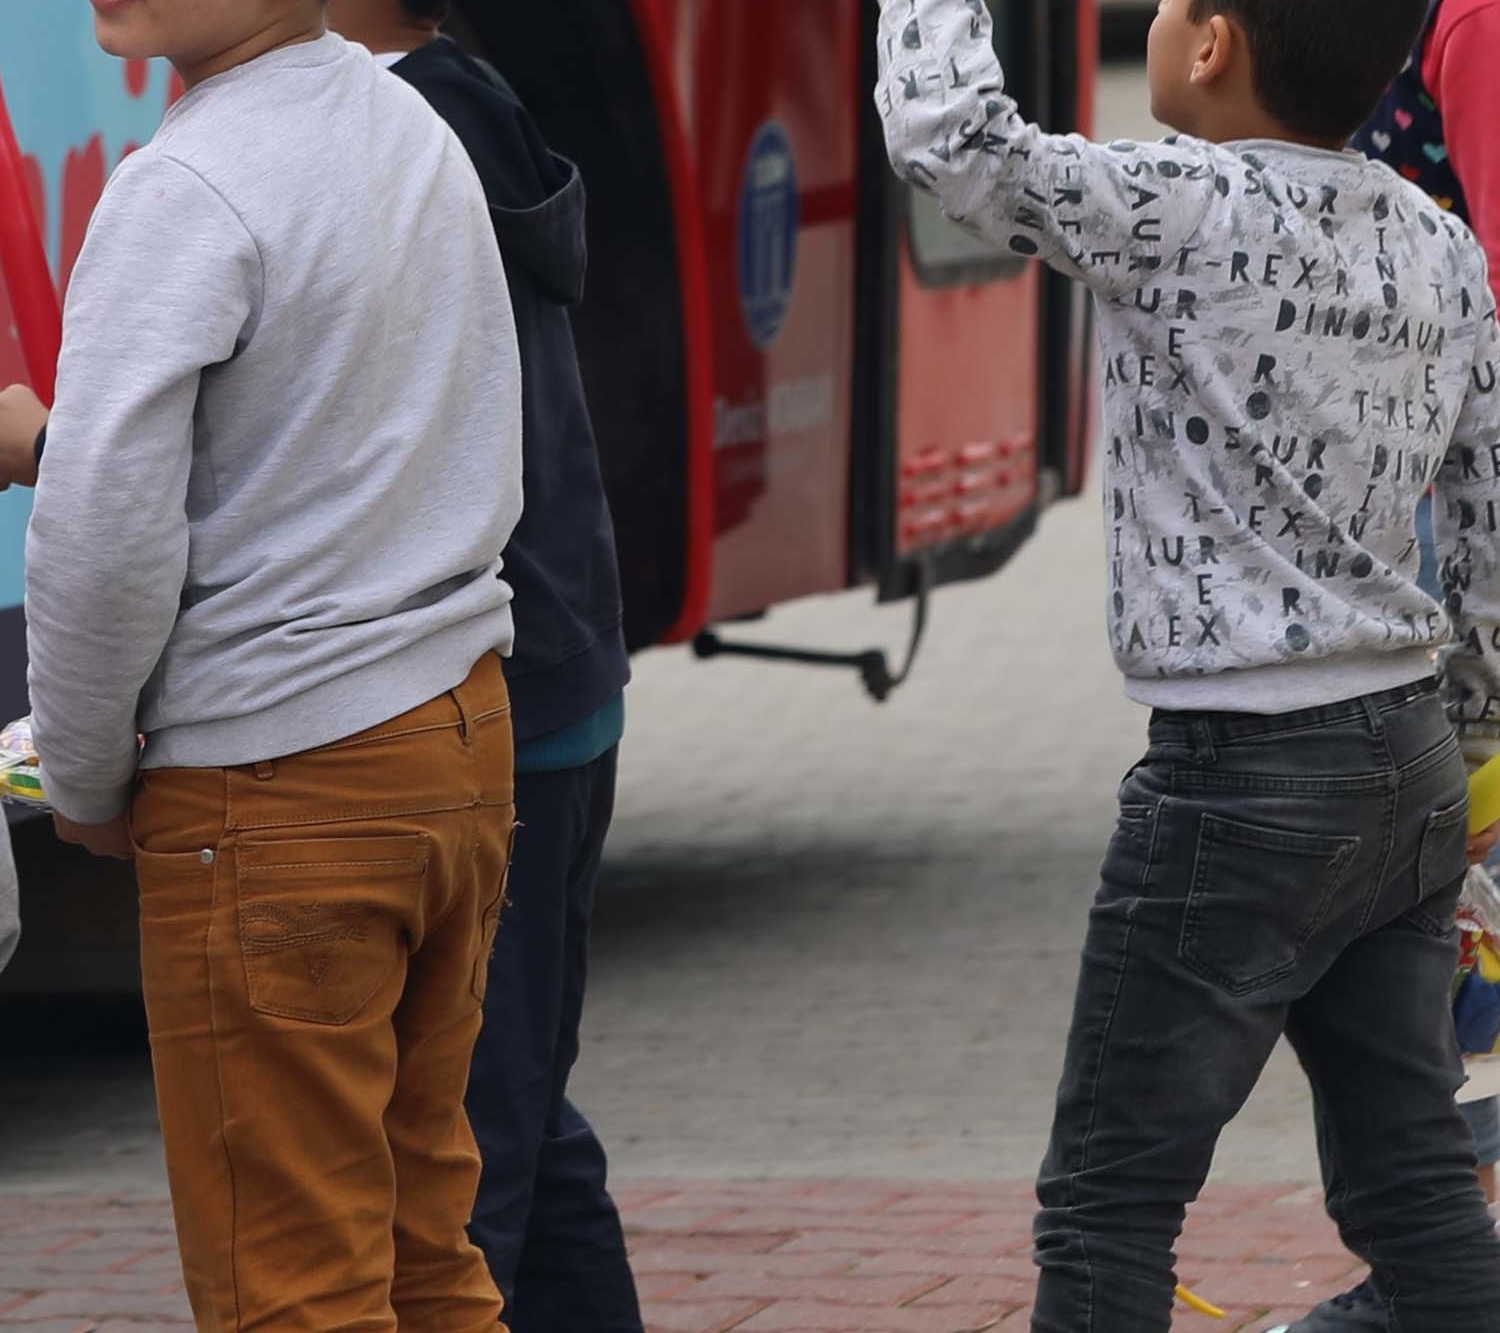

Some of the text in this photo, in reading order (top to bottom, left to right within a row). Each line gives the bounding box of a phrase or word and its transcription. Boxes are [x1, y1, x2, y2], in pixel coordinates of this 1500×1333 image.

[1174, 245, 1320, 292] T-REX
[1274, 297, 1448, 359] DINOSAUR
[1353, 387, 1442, 436] T-REX
[1184, 490, 1305, 539] T-EX
